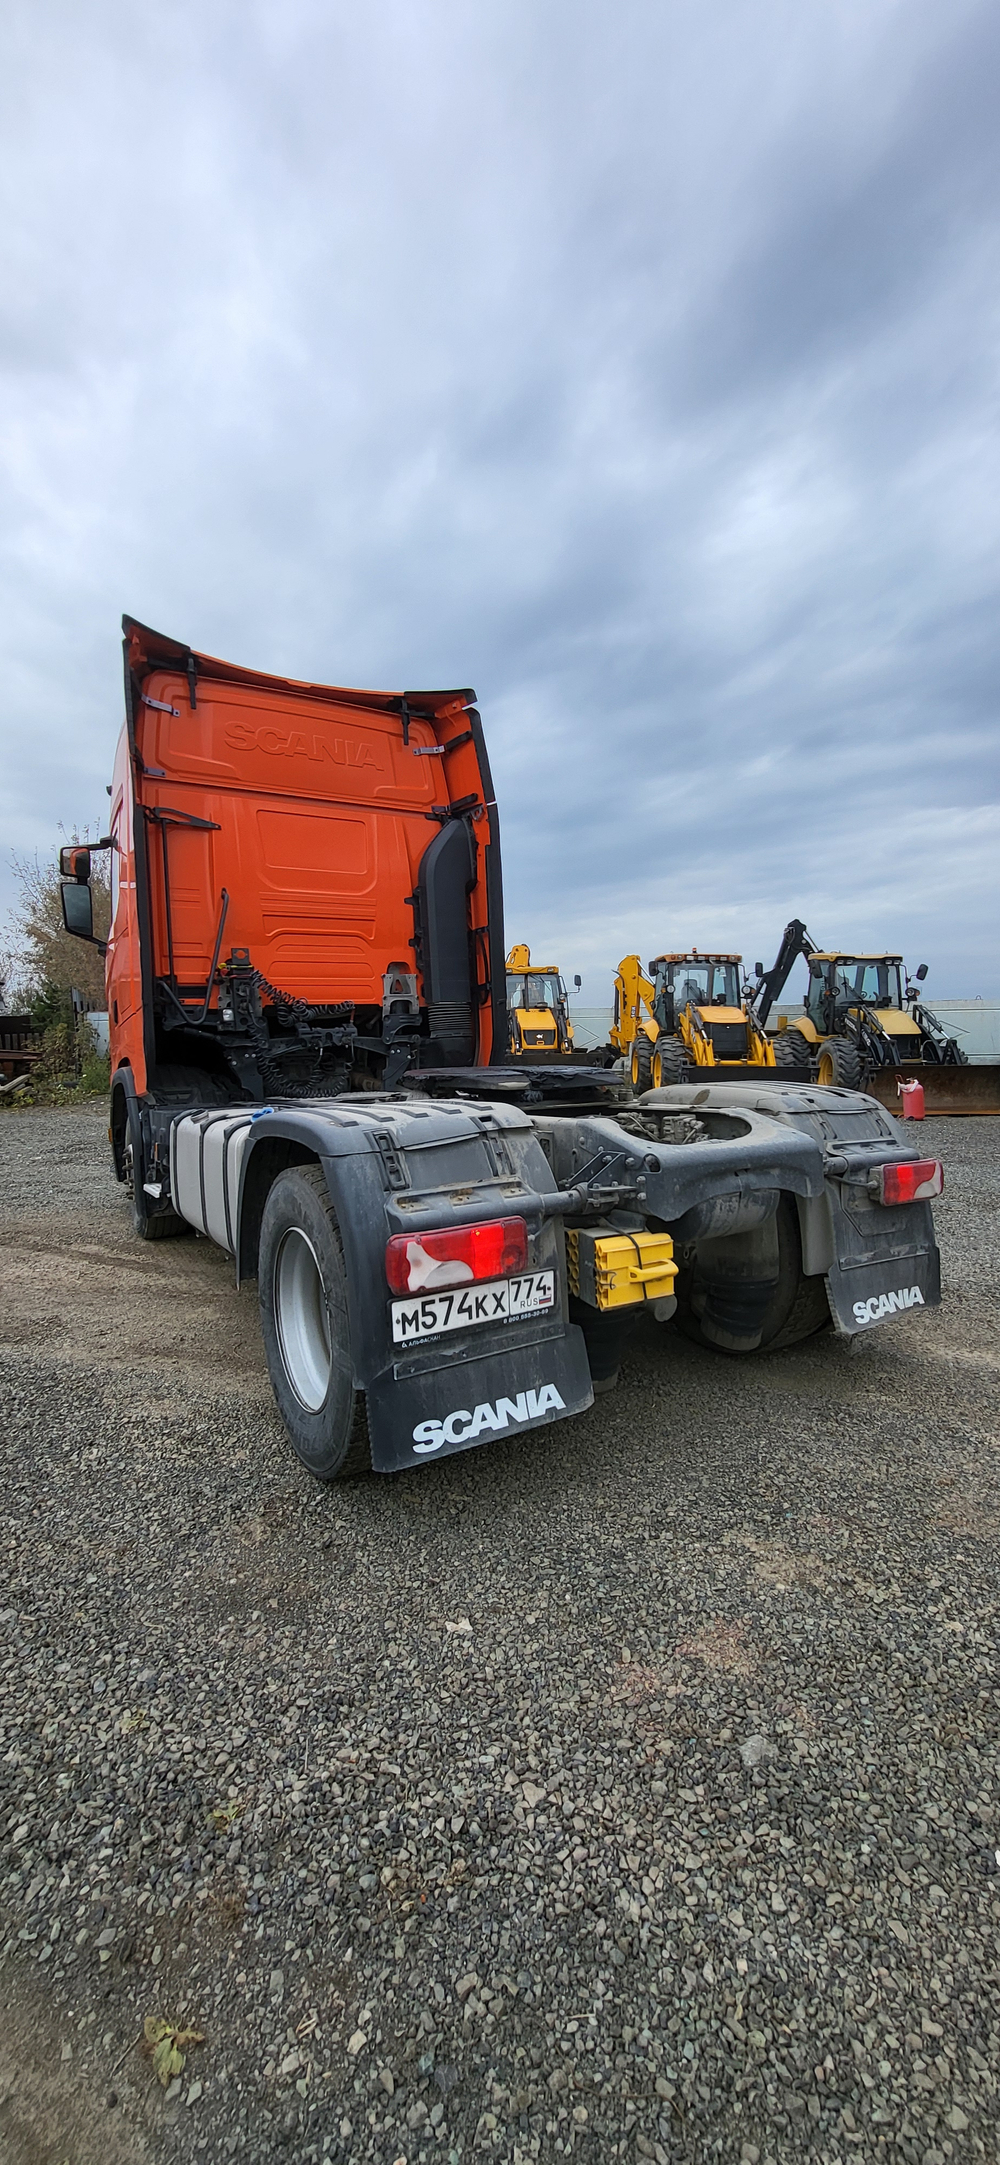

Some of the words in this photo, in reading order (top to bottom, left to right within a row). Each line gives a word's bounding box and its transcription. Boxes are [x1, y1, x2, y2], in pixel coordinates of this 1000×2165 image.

[223, 720, 385, 772] SCANIA
[511, 1275, 547, 1302] 774
[520, 1298, 539, 1309] RUS
[851, 1285, 925, 1325] SCANIA
[412, 1383, 567, 1454] SCANIA
